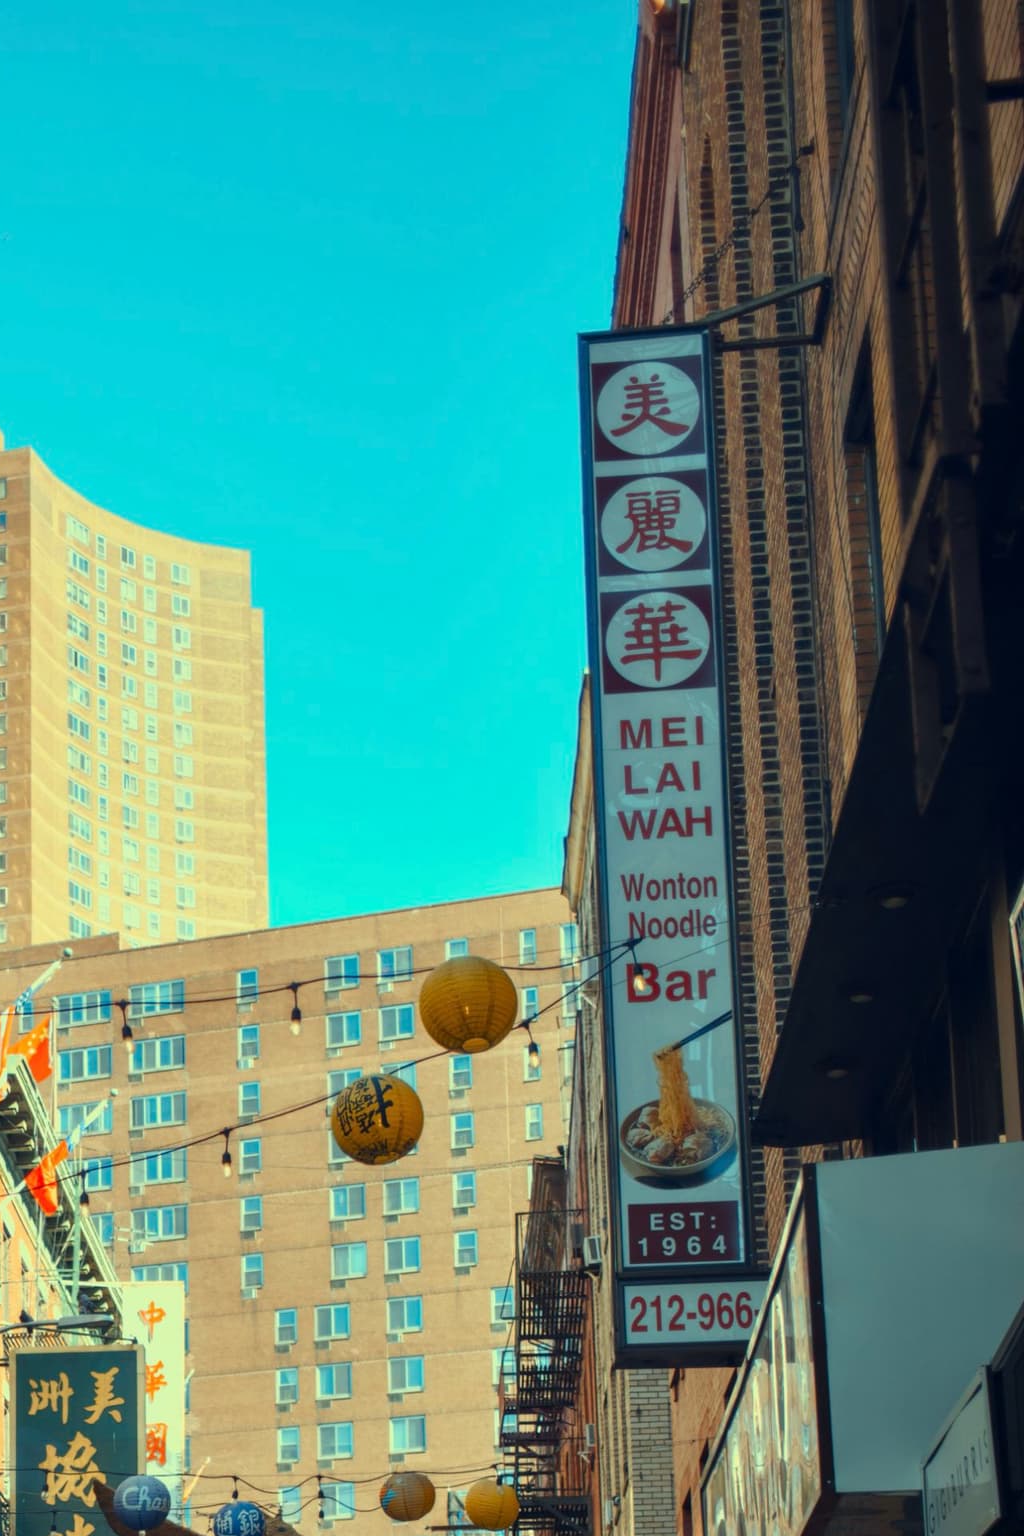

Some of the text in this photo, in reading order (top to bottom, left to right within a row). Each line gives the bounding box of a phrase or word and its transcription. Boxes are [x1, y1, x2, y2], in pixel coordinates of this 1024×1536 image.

[610, 373, 702, 682] 美麗華
[619, 715, 704, 750] MEI
[623, 760, 702, 795] LAI
[617, 805, 714, 841] WAH
[620, 872, 718, 902] Wonton
[628, 909, 717, 940] Noodle
[626, 962, 717, 1003] Bar
[649, 1211, 717, 1232] EST:
[637, 1234, 728, 1257] 1964
[630, 1291, 760, 1333] 212-966-
